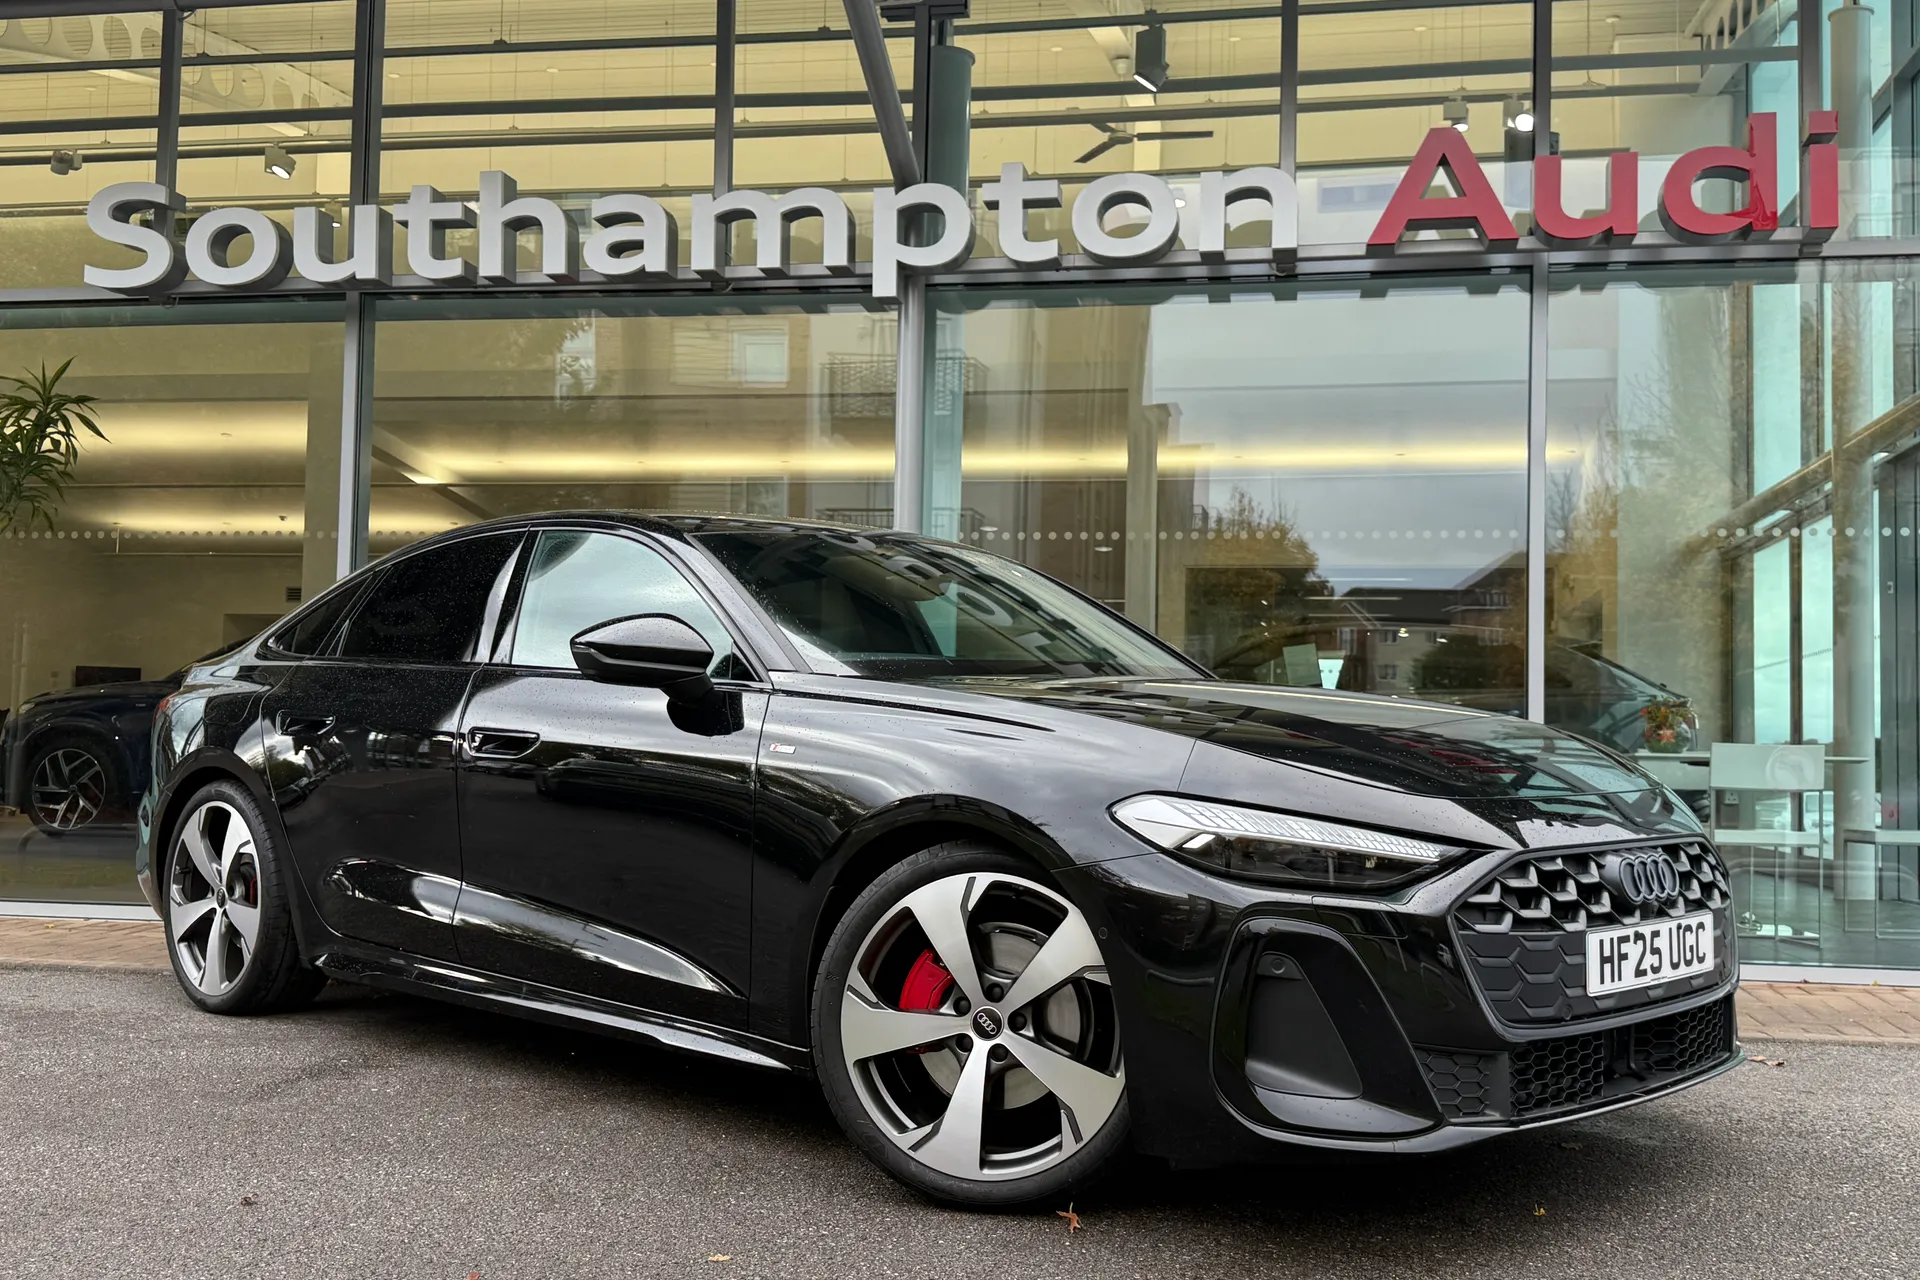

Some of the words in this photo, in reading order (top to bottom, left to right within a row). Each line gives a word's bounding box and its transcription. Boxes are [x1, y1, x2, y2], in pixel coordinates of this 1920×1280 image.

[84, 162, 1298, 301] Southampton
[1367, 111, 1839, 248] Audi
[1599, 930, 1663, 985] HF25
[1668, 921, 1707, 971] UGC
